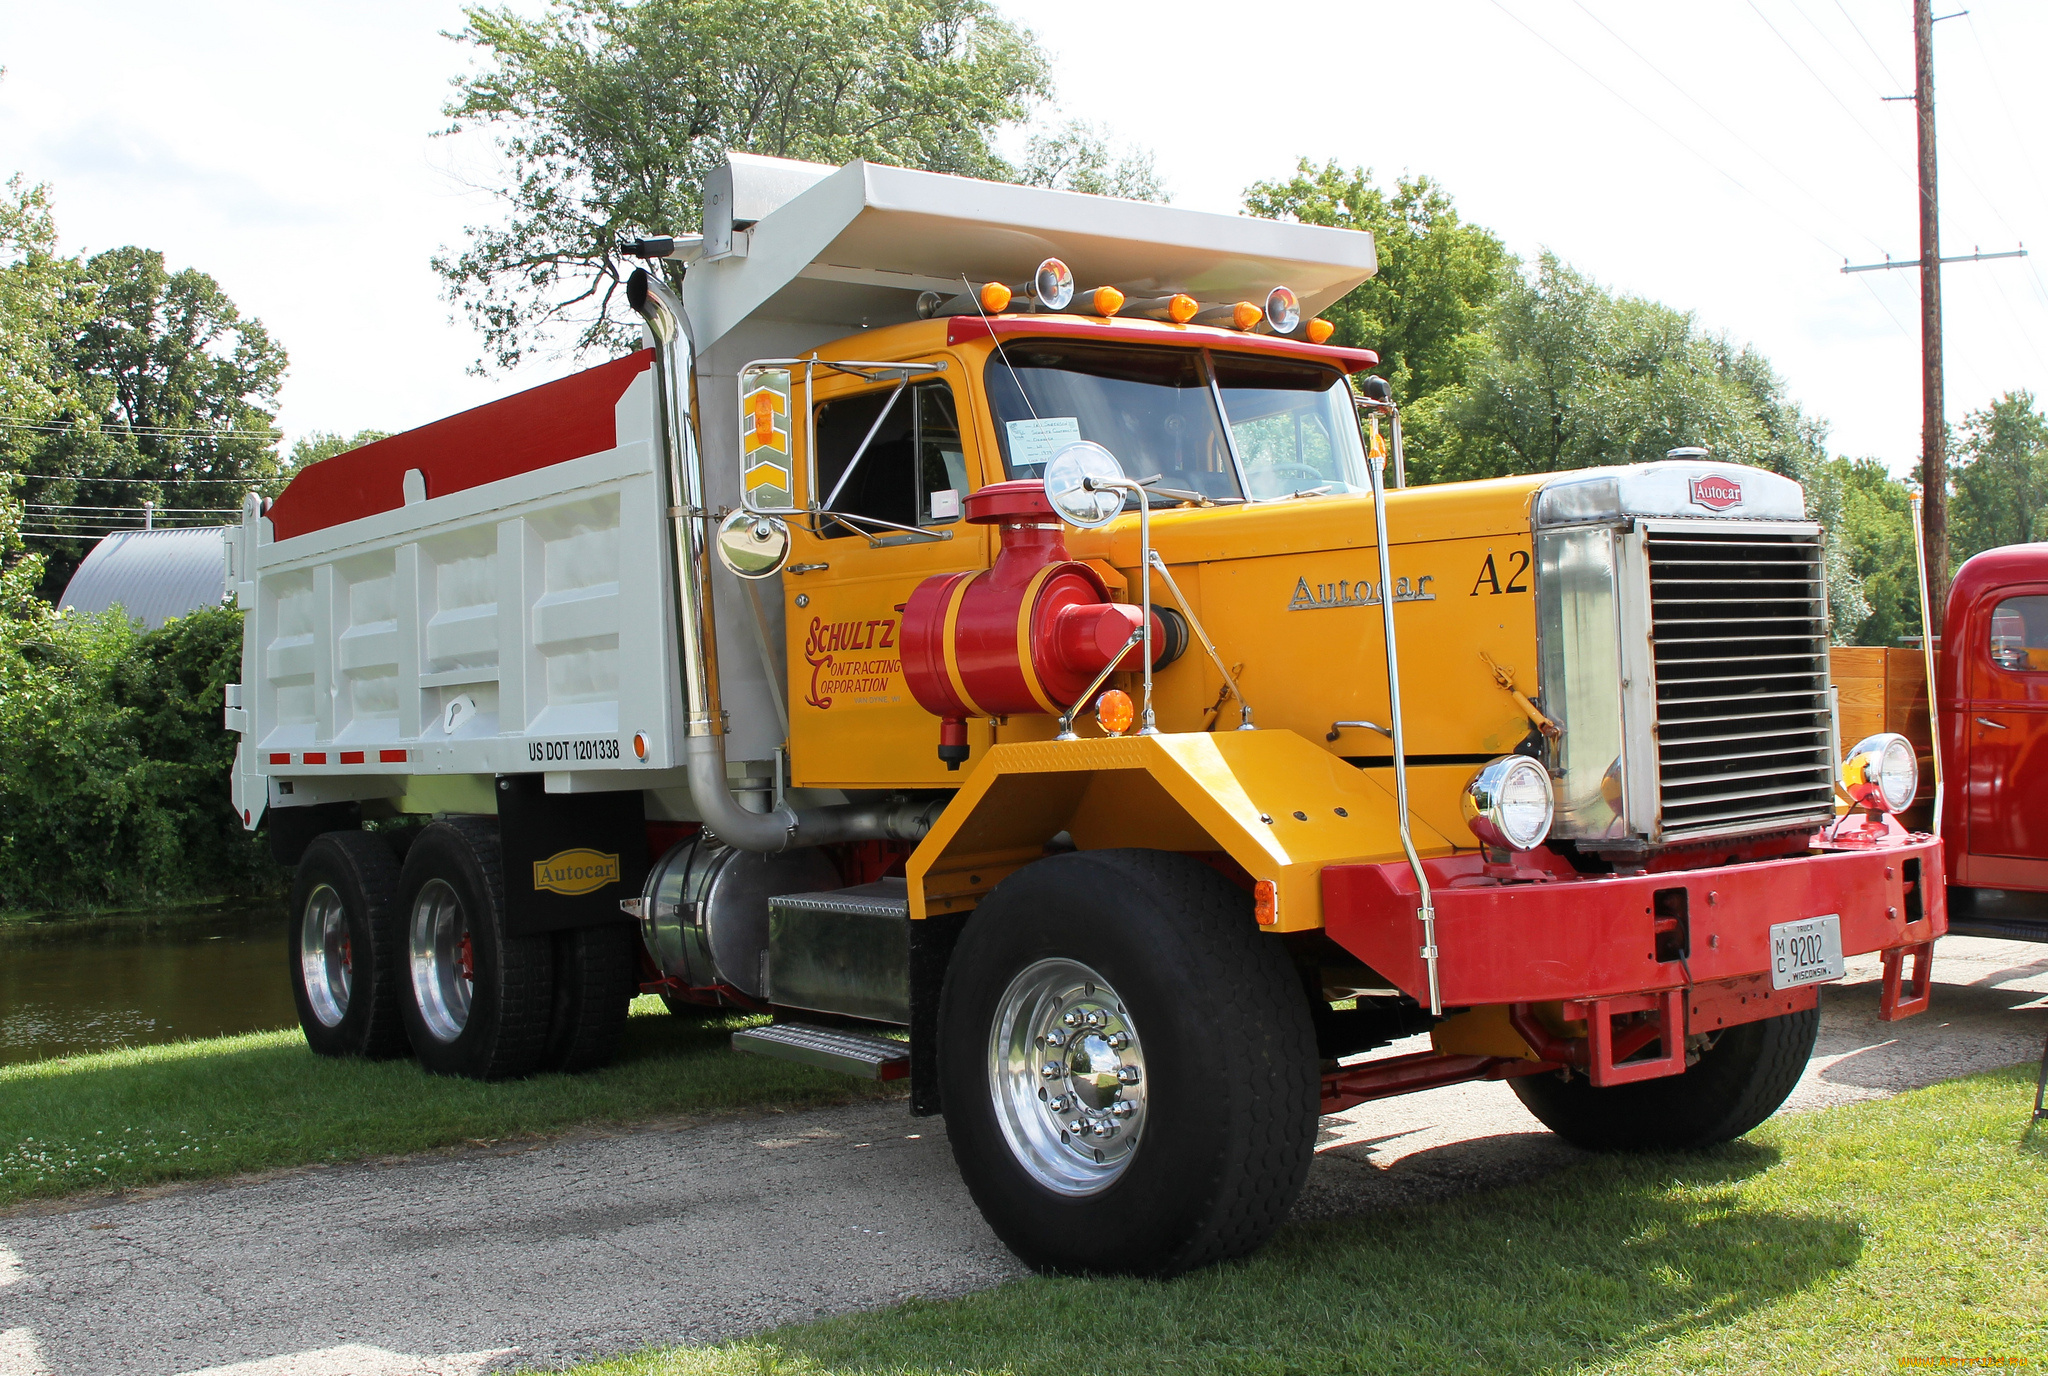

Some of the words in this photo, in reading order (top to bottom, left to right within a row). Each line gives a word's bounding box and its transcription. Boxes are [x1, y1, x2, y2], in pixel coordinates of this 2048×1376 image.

[1696, 484, 1740, 500] Autocar
[1470, 550, 1531, 597] A2
[805, 616, 896, 657] SCHULTZ
[529, 742, 543, 761] US
[546, 741, 569, 760] DOT
[573, 739, 620, 760] 1201338
[540, 863, 613, 883] Autocar
[1796, 924, 1814, 933] TRUCK
[1790, 934, 1824, 968] 9202
[1793, 967, 1827, 981] WISCONSIN
